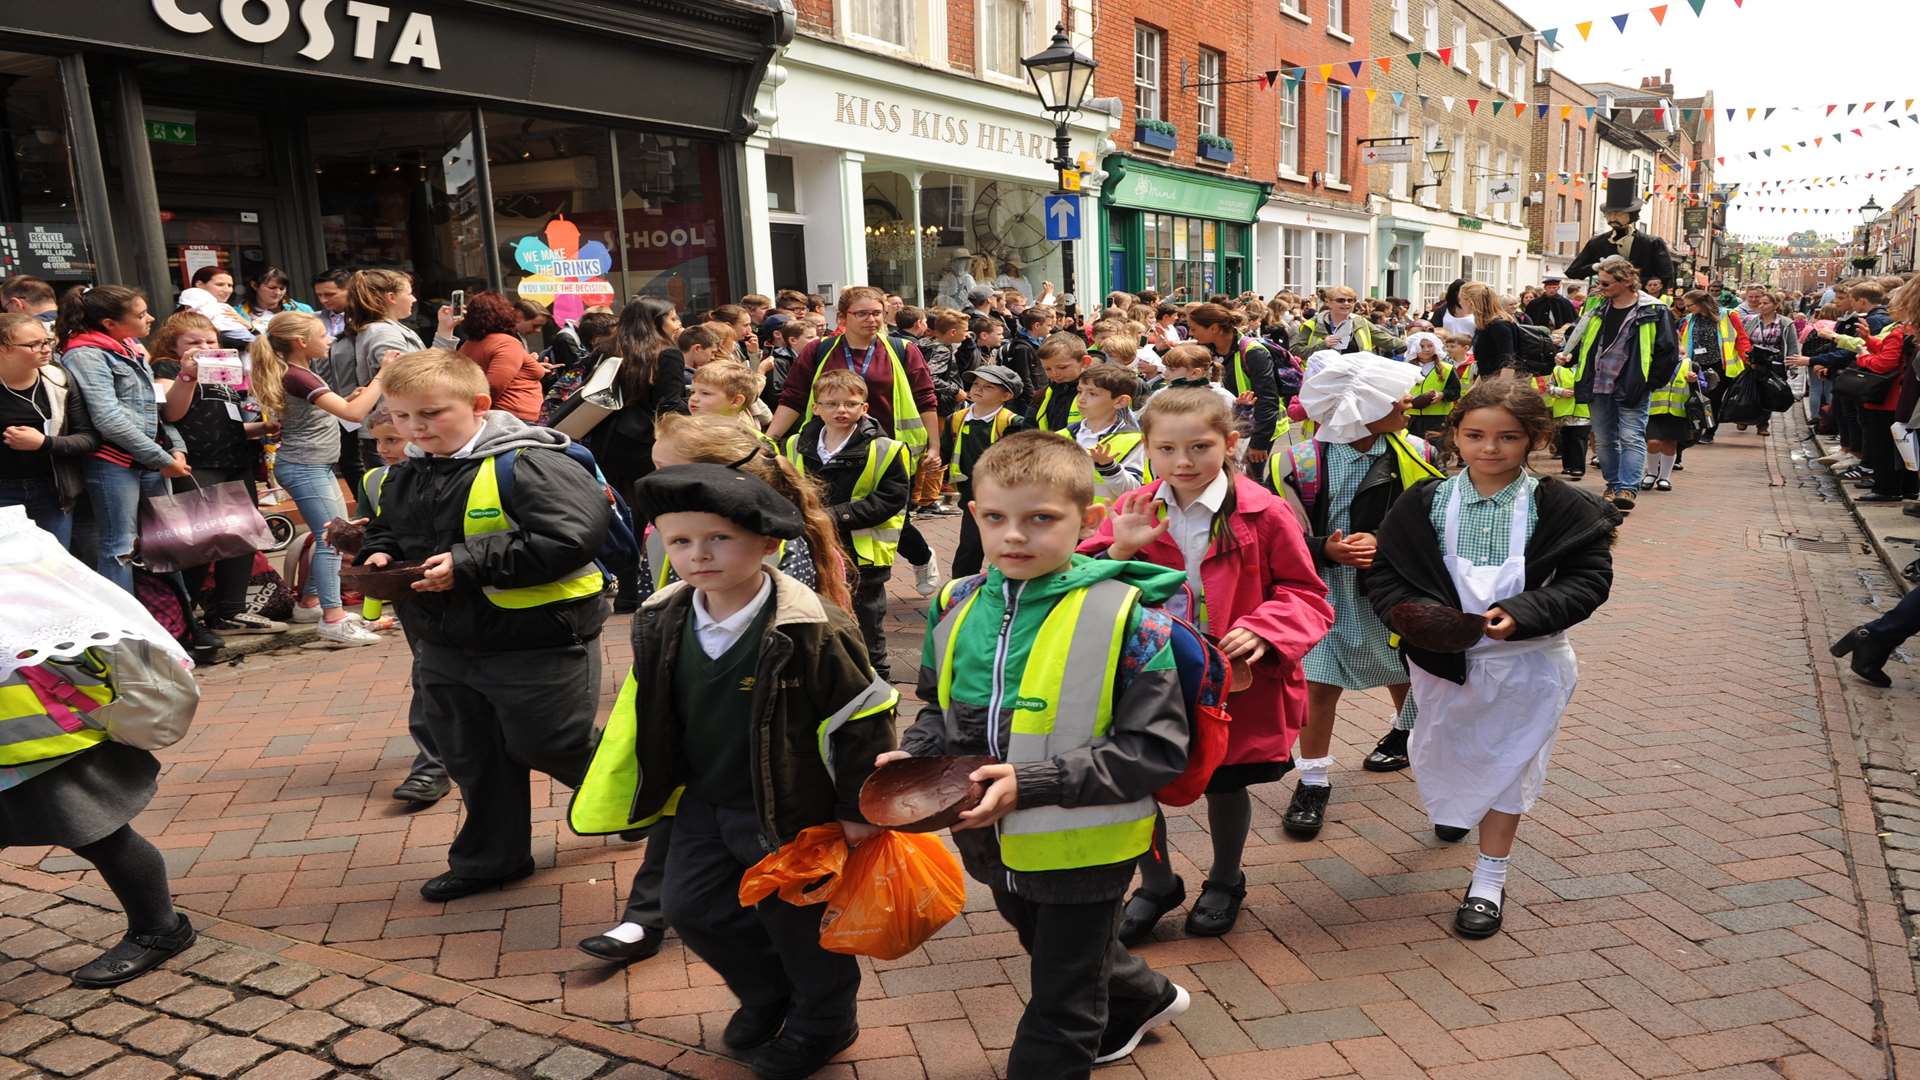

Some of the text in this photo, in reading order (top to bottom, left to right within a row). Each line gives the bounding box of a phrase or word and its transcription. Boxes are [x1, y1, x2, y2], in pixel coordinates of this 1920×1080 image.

[153, 0, 441, 70] COSTA
[834, 92, 902, 133] KISS
[911, 108, 969, 146] KISS
[31, 233, 63, 242] RECYCLE
[522, 248, 567, 262] WE MAKE
[534, 260, 600, 276] THE DRINKS
[523, 284, 538, 293] YOU
[561, 284, 573, 292] THE
[248, 582, 278, 615] didas
